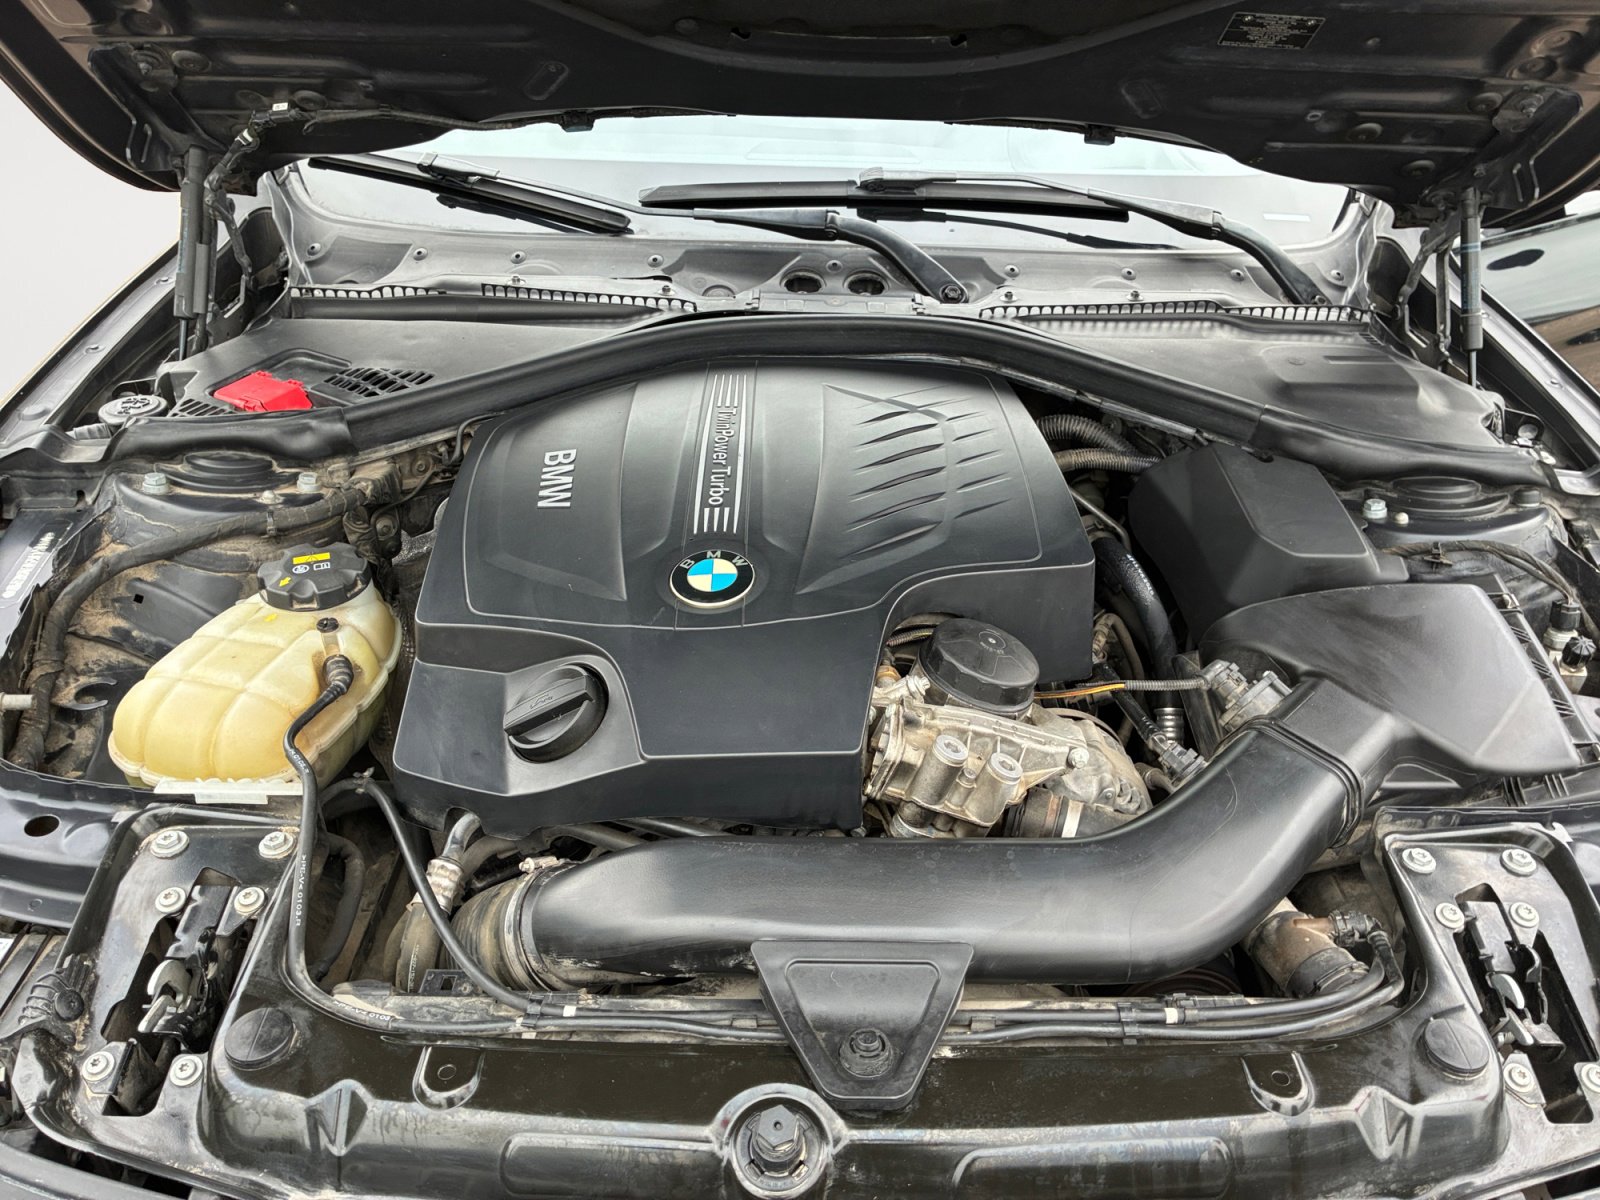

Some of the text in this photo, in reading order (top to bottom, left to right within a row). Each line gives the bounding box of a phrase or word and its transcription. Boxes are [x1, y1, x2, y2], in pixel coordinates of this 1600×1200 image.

[537, 448, 577, 508] BMW
[708, 406, 737, 506] TwinPower Turbo
[681, 551, 748, 569] BMW
